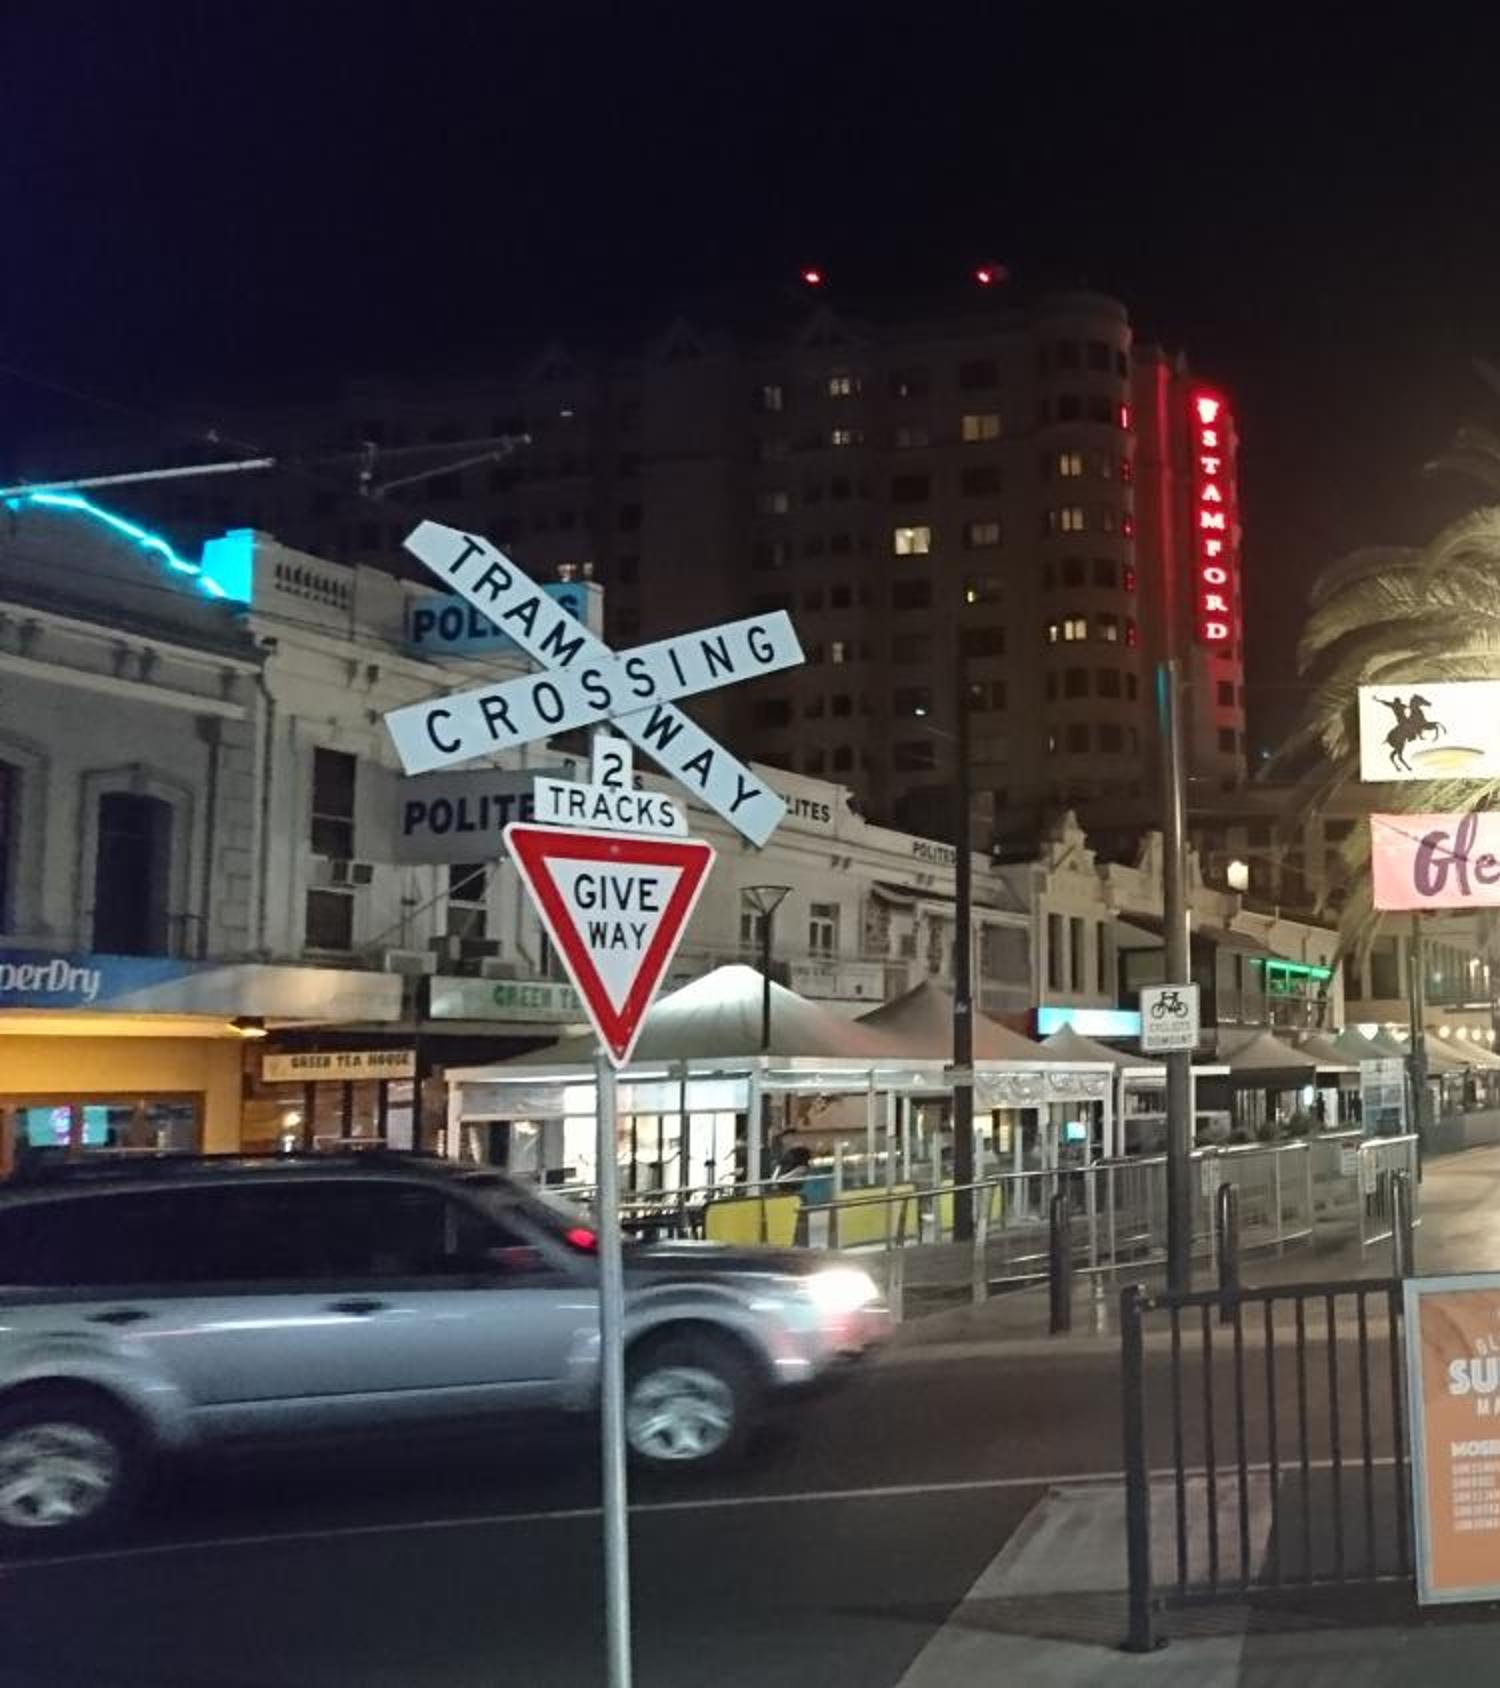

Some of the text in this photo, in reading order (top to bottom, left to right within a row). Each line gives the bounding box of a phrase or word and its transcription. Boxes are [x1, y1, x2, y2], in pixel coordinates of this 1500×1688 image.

[1201, 428, 1228, 640] STAMFORD
[426, 625, 775, 753] CROSSING
[447, 535, 762, 814] TRAM WAY
[602, 754, 625, 787] 2
[549, 785, 675, 828] TRACKS
[784, 797, 831, 823] LITES
[574, 873, 660, 913] GIVE
[588, 922, 649, 951] WAY
